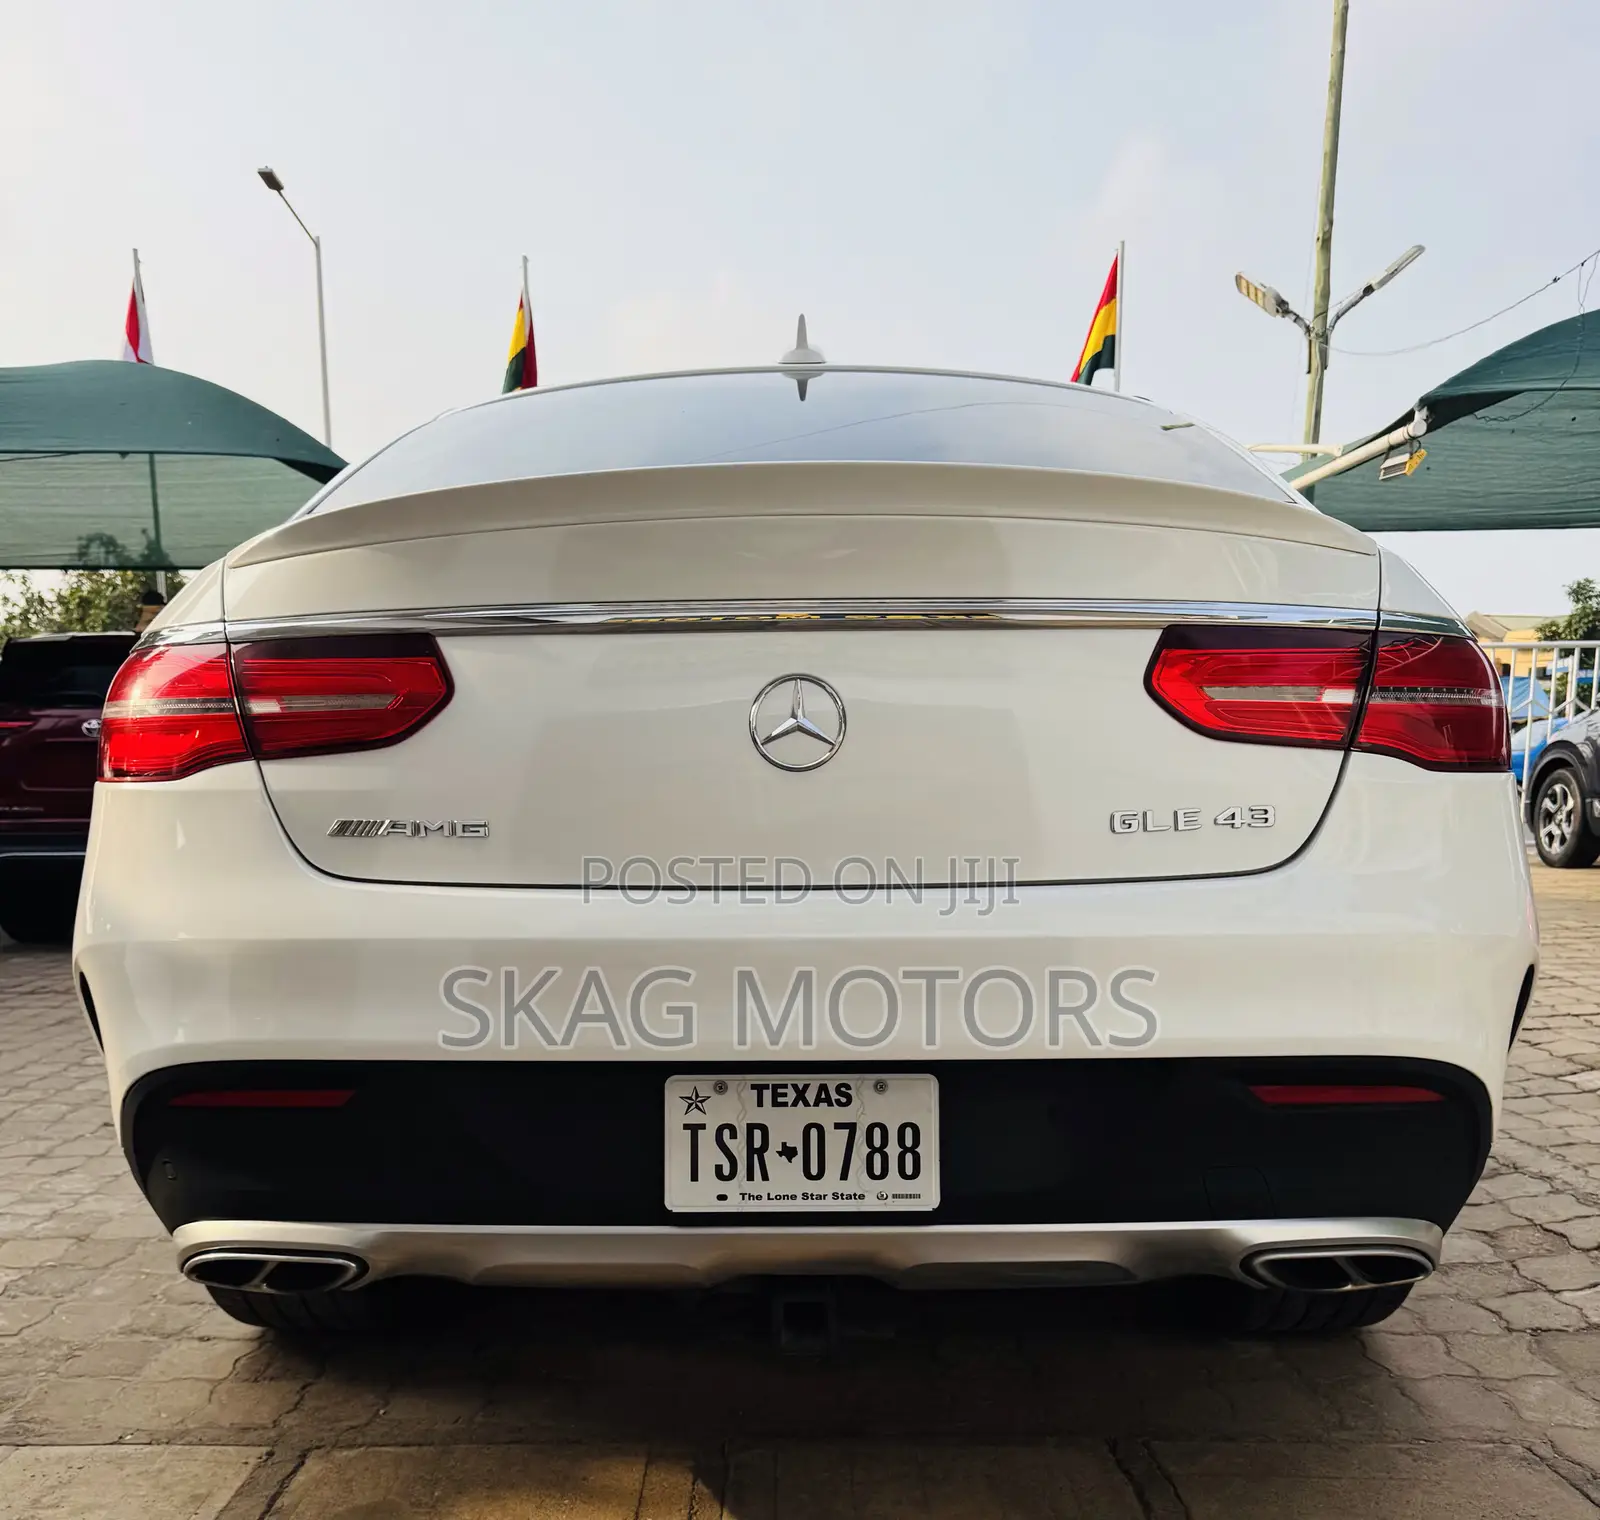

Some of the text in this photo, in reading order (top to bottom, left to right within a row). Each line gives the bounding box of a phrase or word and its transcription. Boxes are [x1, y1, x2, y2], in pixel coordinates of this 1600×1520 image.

[376, 819, 489, 838] AMG
[1110, 805, 1276, 834] GLE 43
[750, 1082, 853, 1108] TEXAS
[739, 1192, 866, 1201] The Lone Star State
